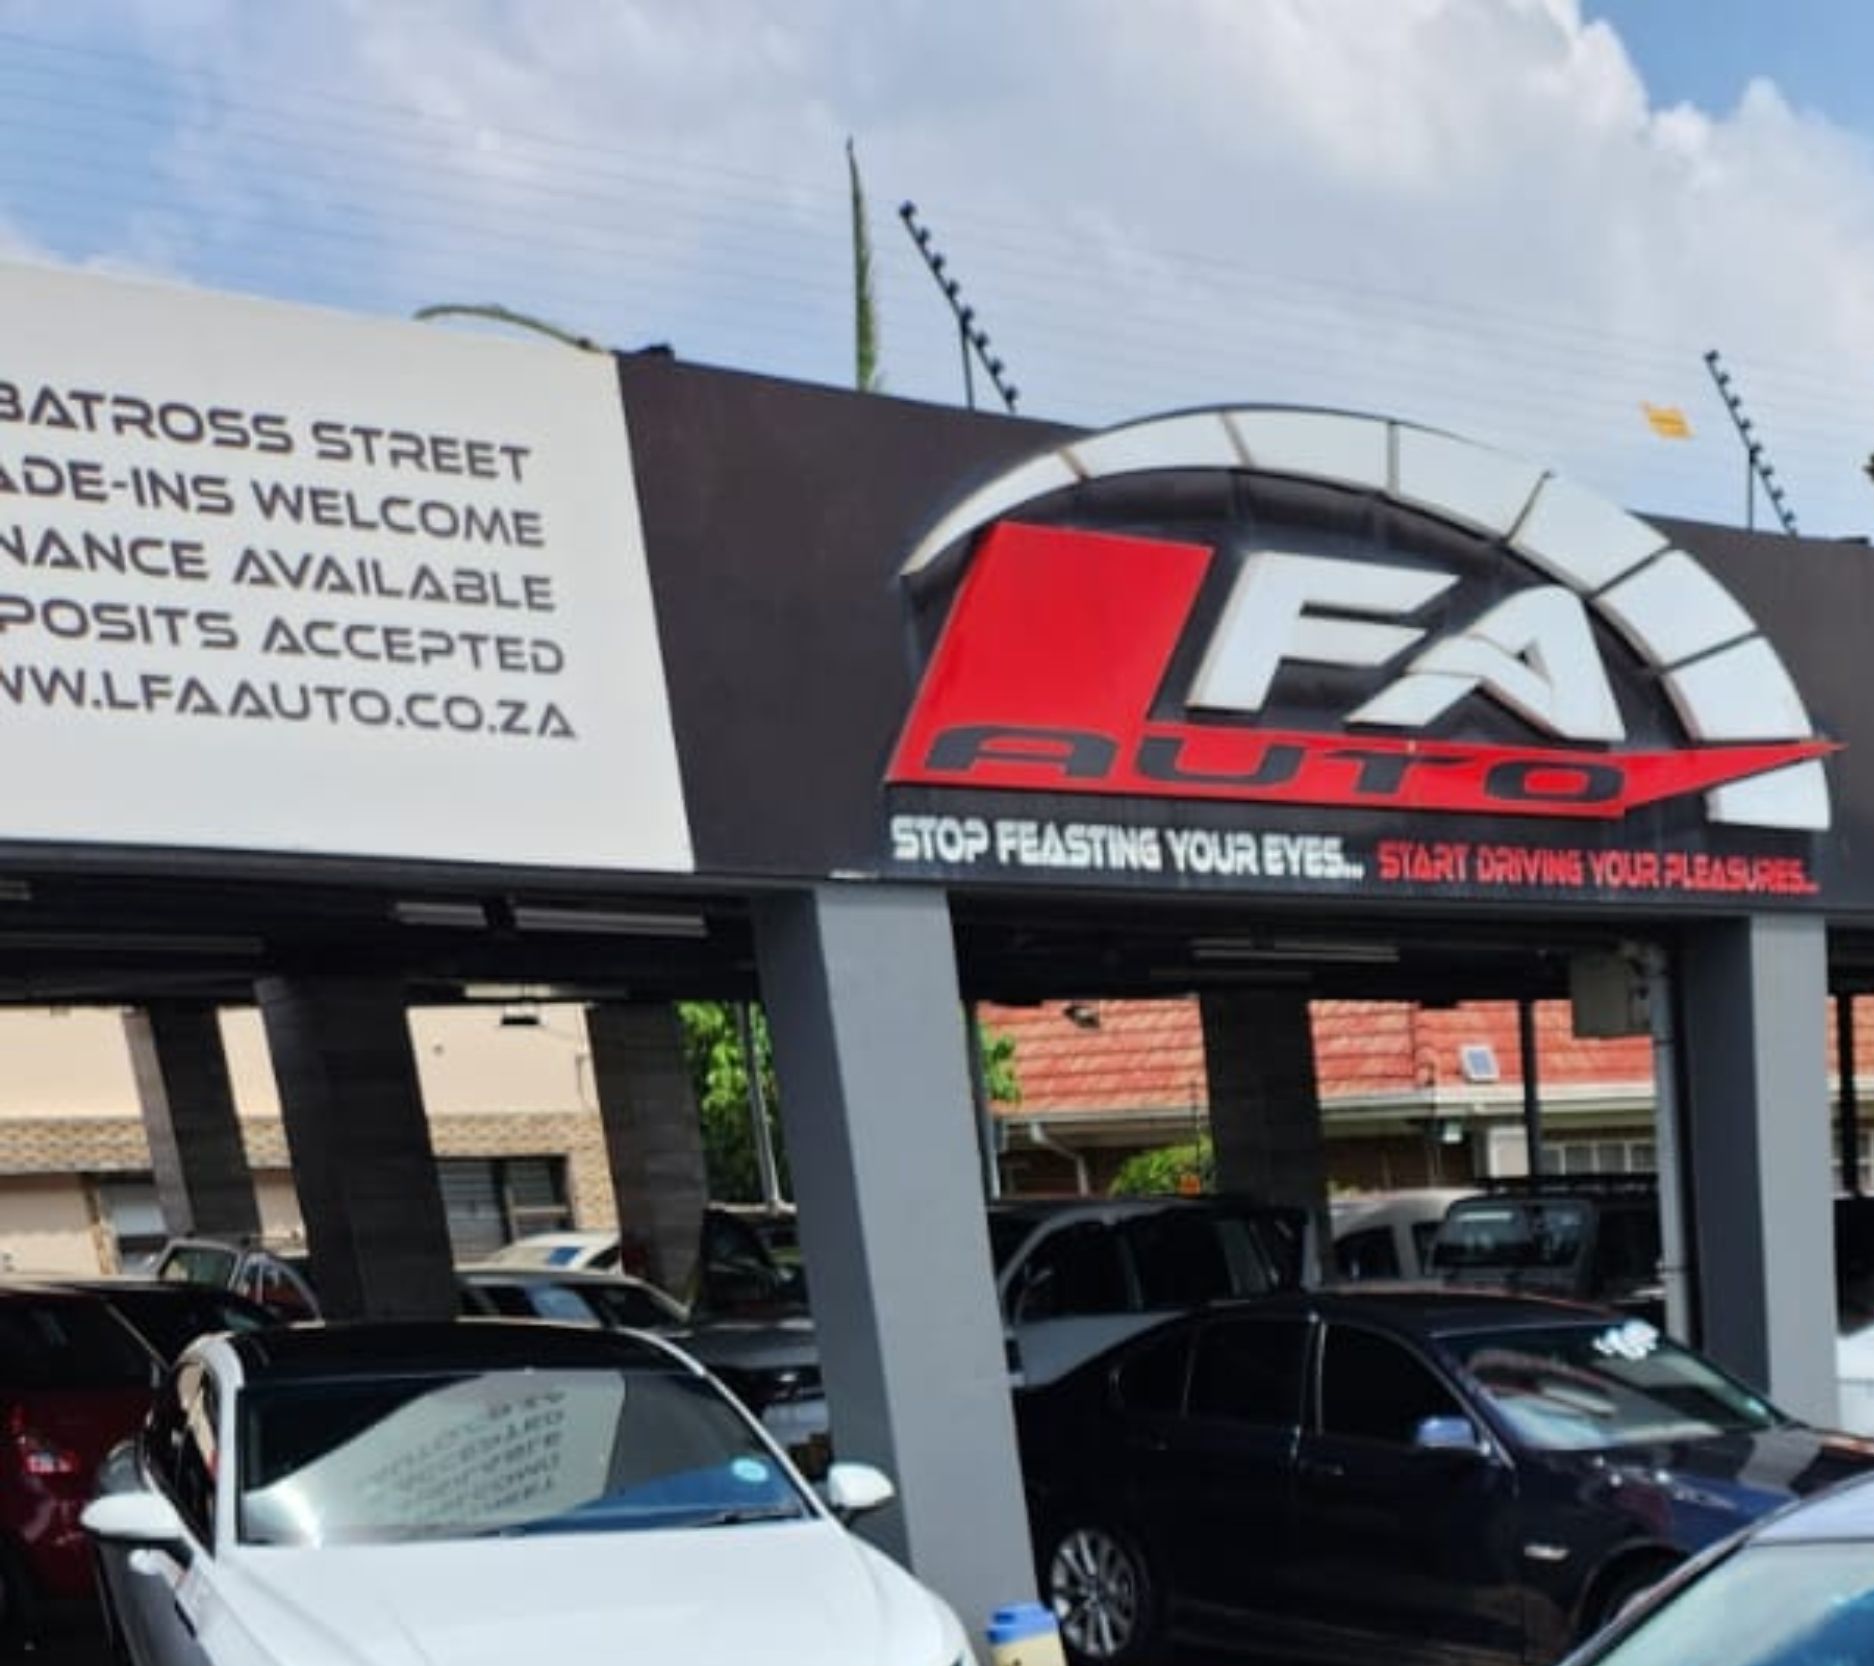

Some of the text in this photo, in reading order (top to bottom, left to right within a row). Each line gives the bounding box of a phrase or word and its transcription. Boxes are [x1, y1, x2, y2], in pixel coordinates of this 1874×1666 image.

[0, 380, 531, 484] BATROSS STREET
[250, 479, 546, 549] WELCOME
[232, 546, 556, 612] AVAILABLE
[0, 593, 565, 676] POSITS ACCEPTED
[924, 724, 1624, 802] AUTO
[889, 814, 989, 864] STOP
[995, 818, 1163, 871] FEASTING
[1165, 829, 1260, 876] YOUR
[1377, 839, 1469, 881] START
[1476, 843, 1586, 886] DRIVING
[1588, 850, 1662, 890] YOUR
